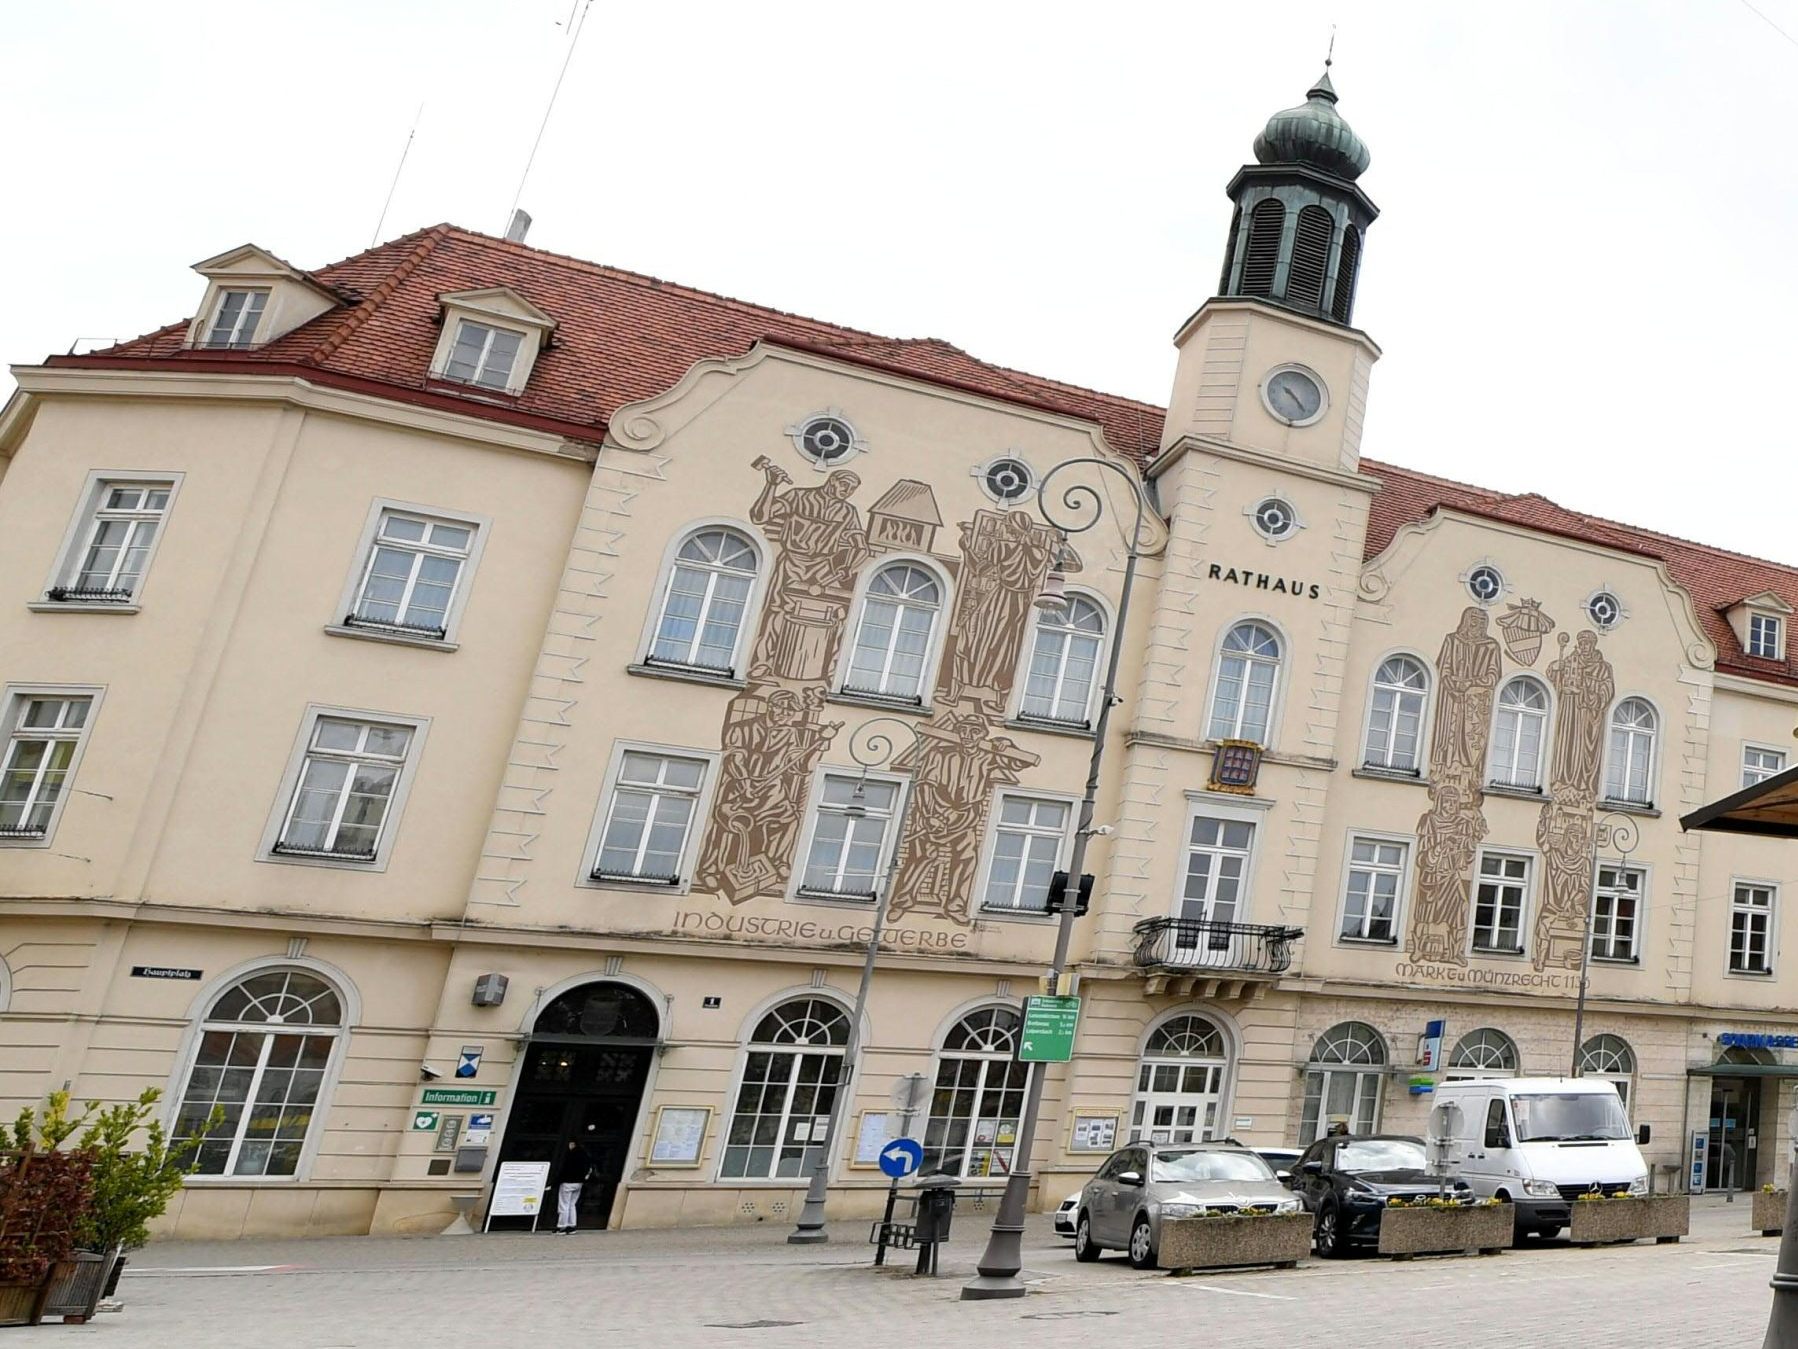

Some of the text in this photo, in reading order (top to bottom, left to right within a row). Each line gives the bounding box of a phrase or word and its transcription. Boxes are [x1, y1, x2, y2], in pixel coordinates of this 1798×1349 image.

[1208, 564, 1320, 600] RATHAUS
[673, 911, 817, 939] INDUSTRIE
[837, 925, 967, 948] GEWERBE
[1396, 963, 1458, 981] MARKT
[425, 1091, 478, 1103] Information
